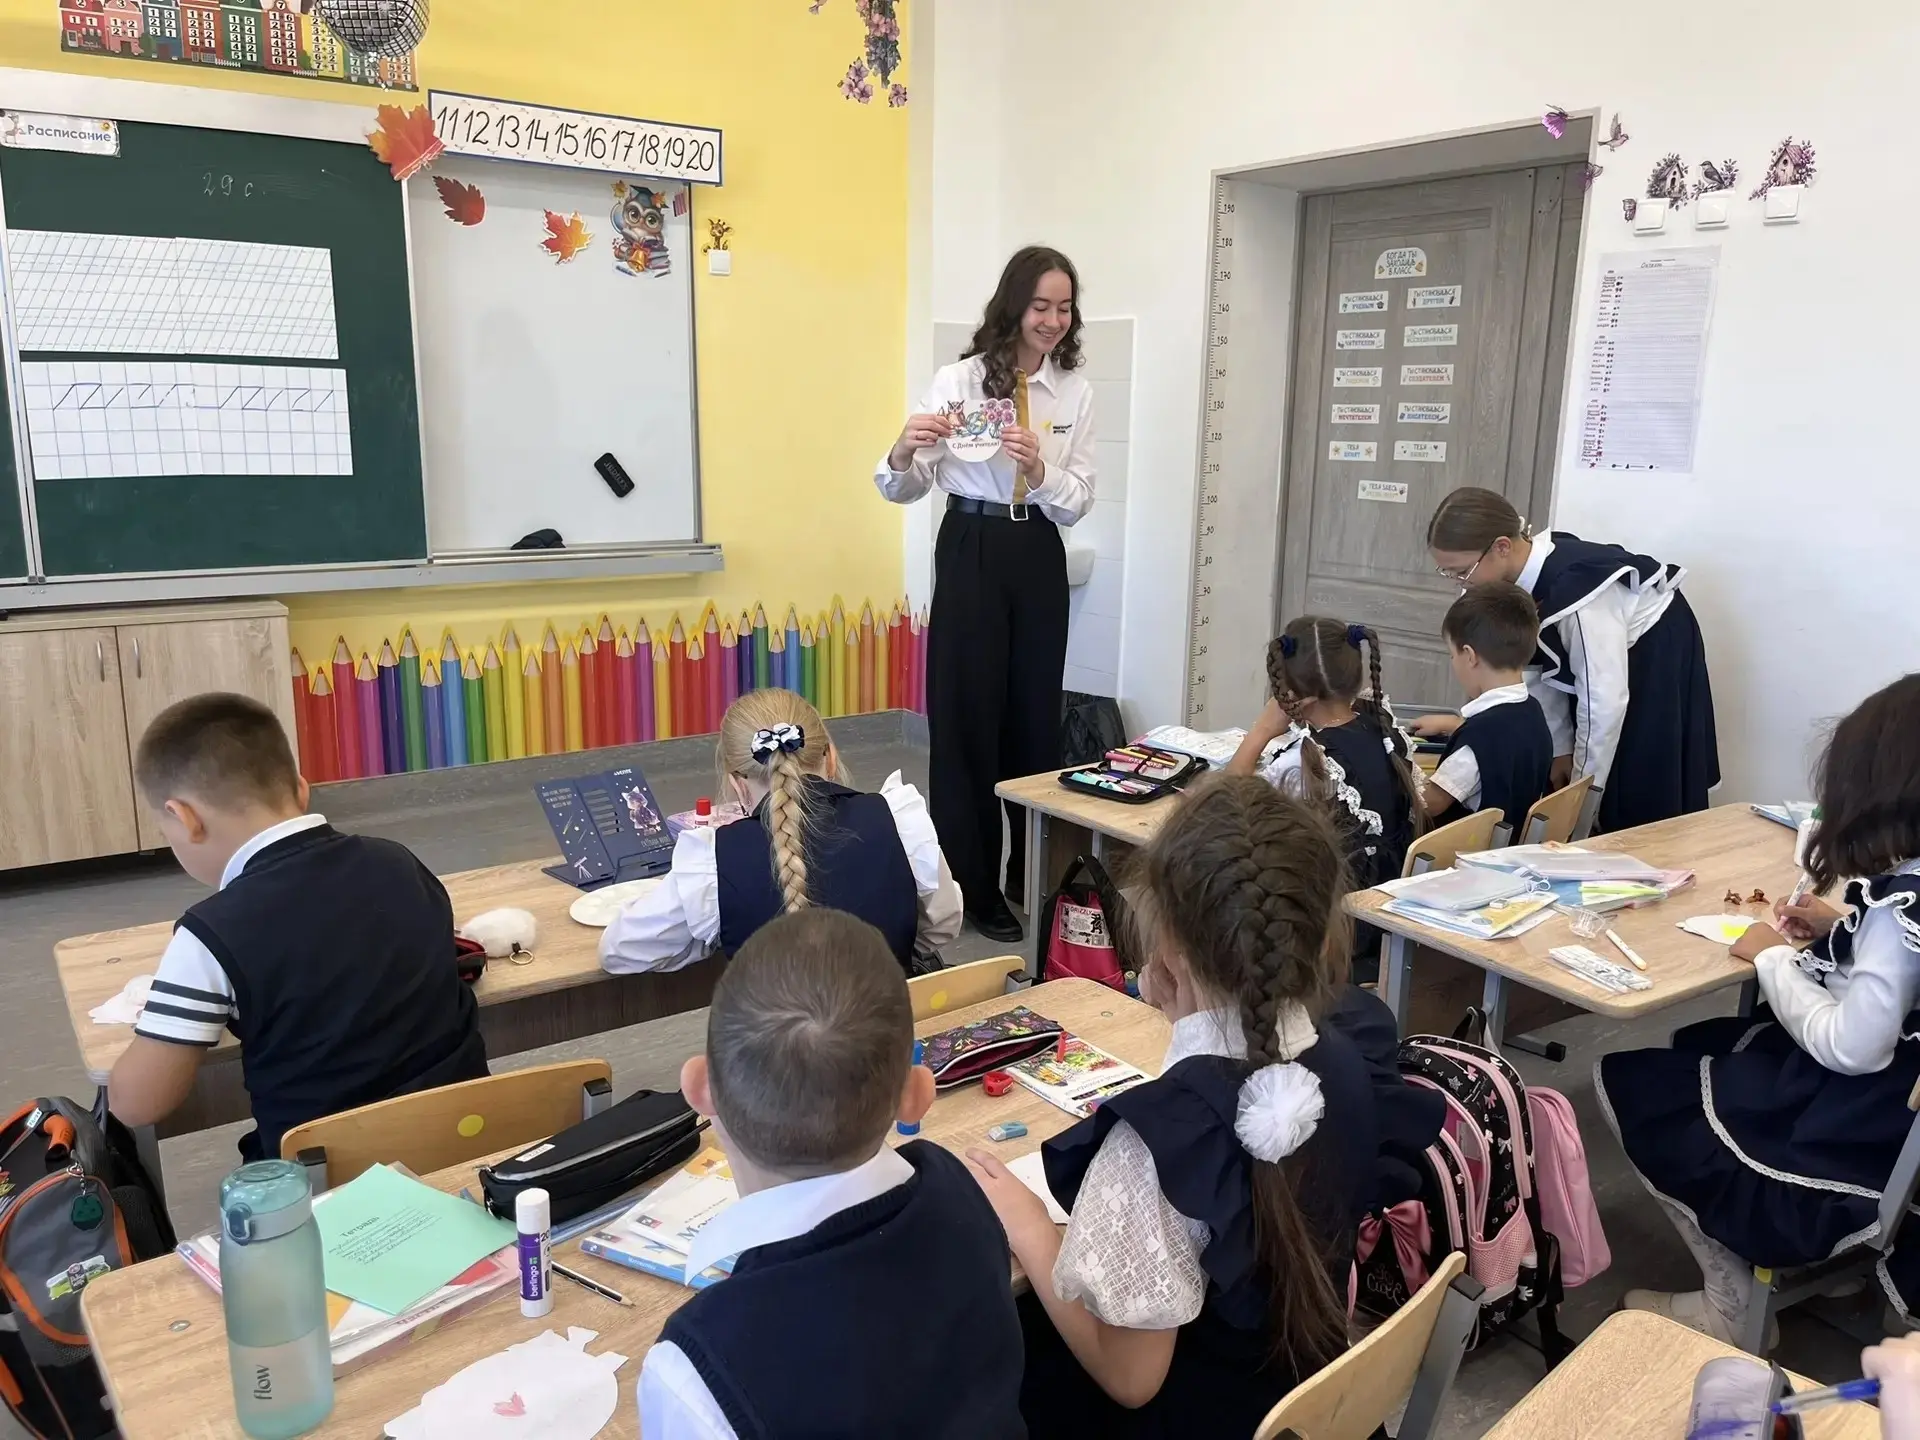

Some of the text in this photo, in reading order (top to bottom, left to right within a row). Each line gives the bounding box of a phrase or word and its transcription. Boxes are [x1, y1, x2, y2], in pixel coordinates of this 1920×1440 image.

[28, 124, 112, 142] Расписание
[437, 107, 714, 171] 11 12 13 14 15 16 17 18 19 20
[1224, 204, 1234, 213] 190
[1222, 239, 1232, 247] 180
[1394, 266, 1412, 274] КЛАСС
[1220, 272, 1231, 280] 170
[1218, 304, 1229, 312] 160
[1217, 336, 1228, 344] 150
[1215, 369, 1226, 377] 140
[1214, 402, 1224, 410] 130
[1212, 433, 1222, 441] 120
[1209, 464, 1219, 472] 110
[1207, 495, 1217, 503] 100
[530, 1266, 539, 1296] berlingo
[253, 1364, 273, 1400] flow
